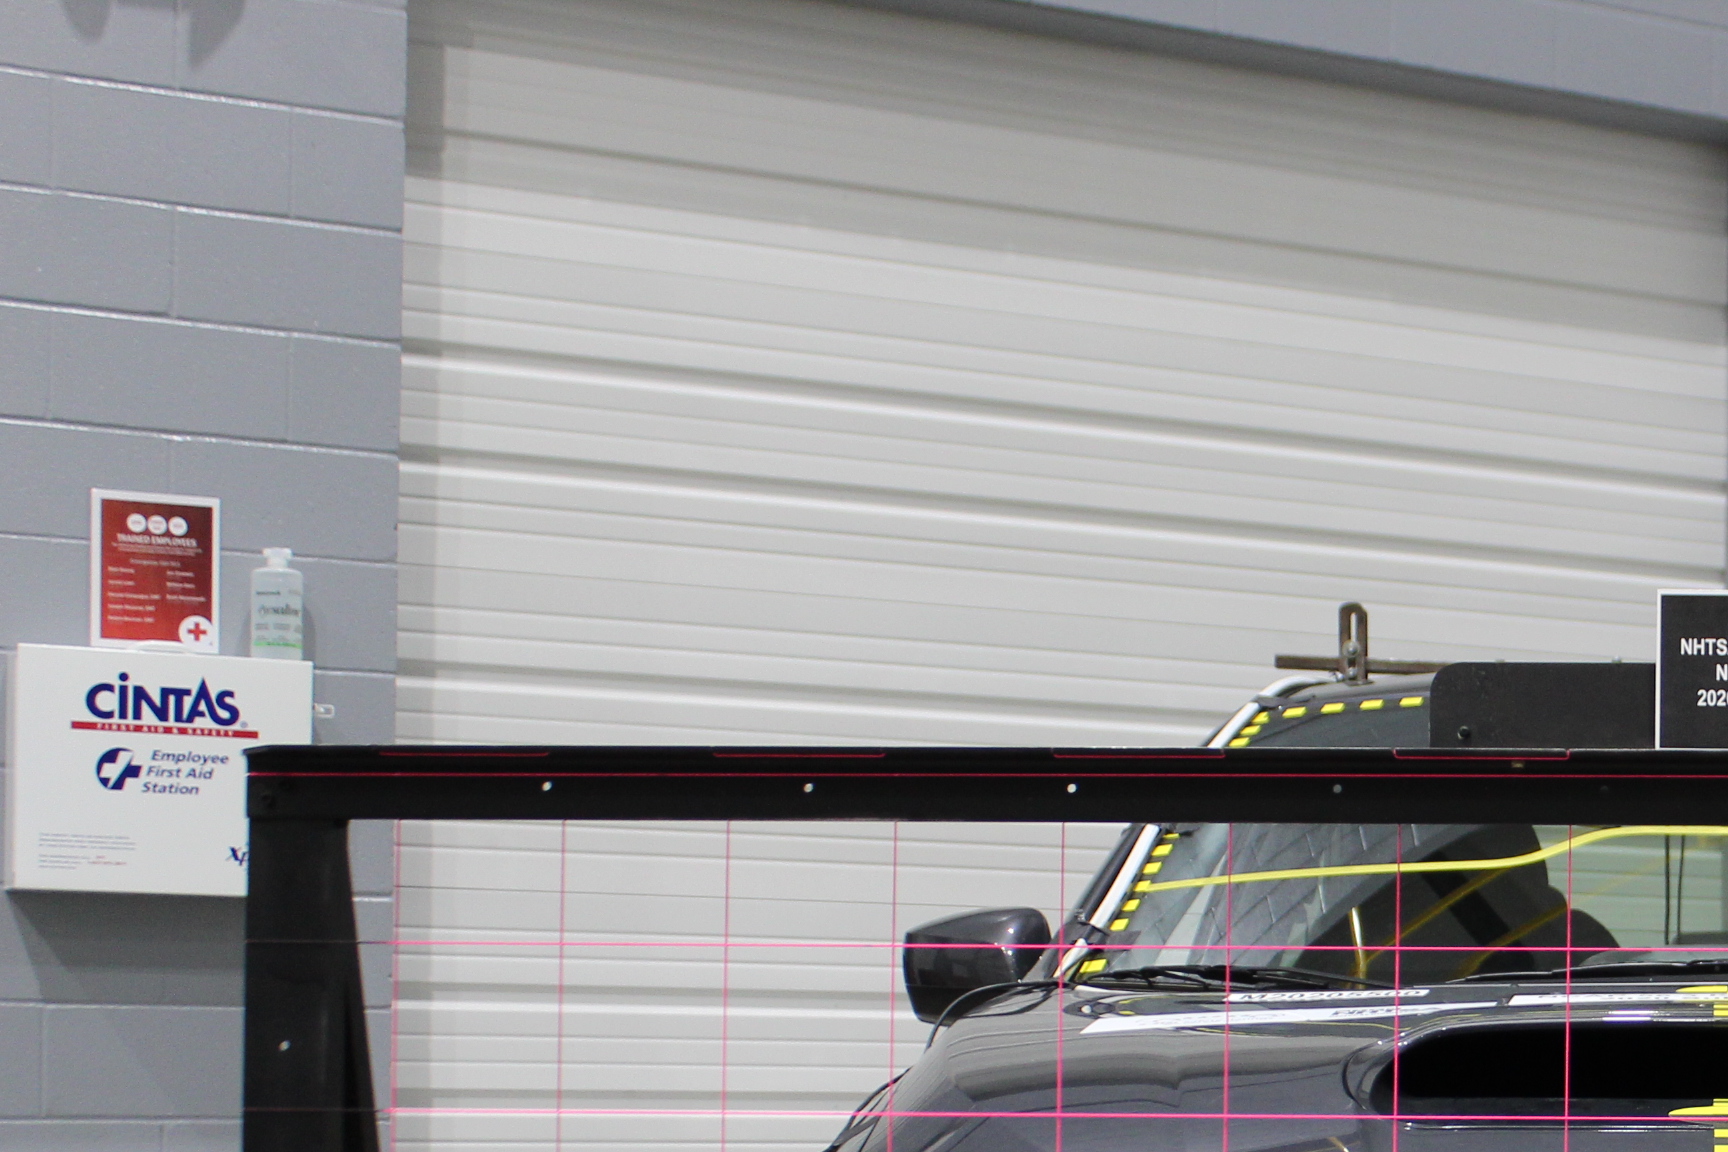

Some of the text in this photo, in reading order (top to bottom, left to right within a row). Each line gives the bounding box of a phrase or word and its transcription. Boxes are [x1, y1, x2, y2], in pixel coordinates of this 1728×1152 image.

[151, 750, 229, 765] Employee
[146, 765, 213, 780] First Aid
[142, 781, 199, 795] Station
